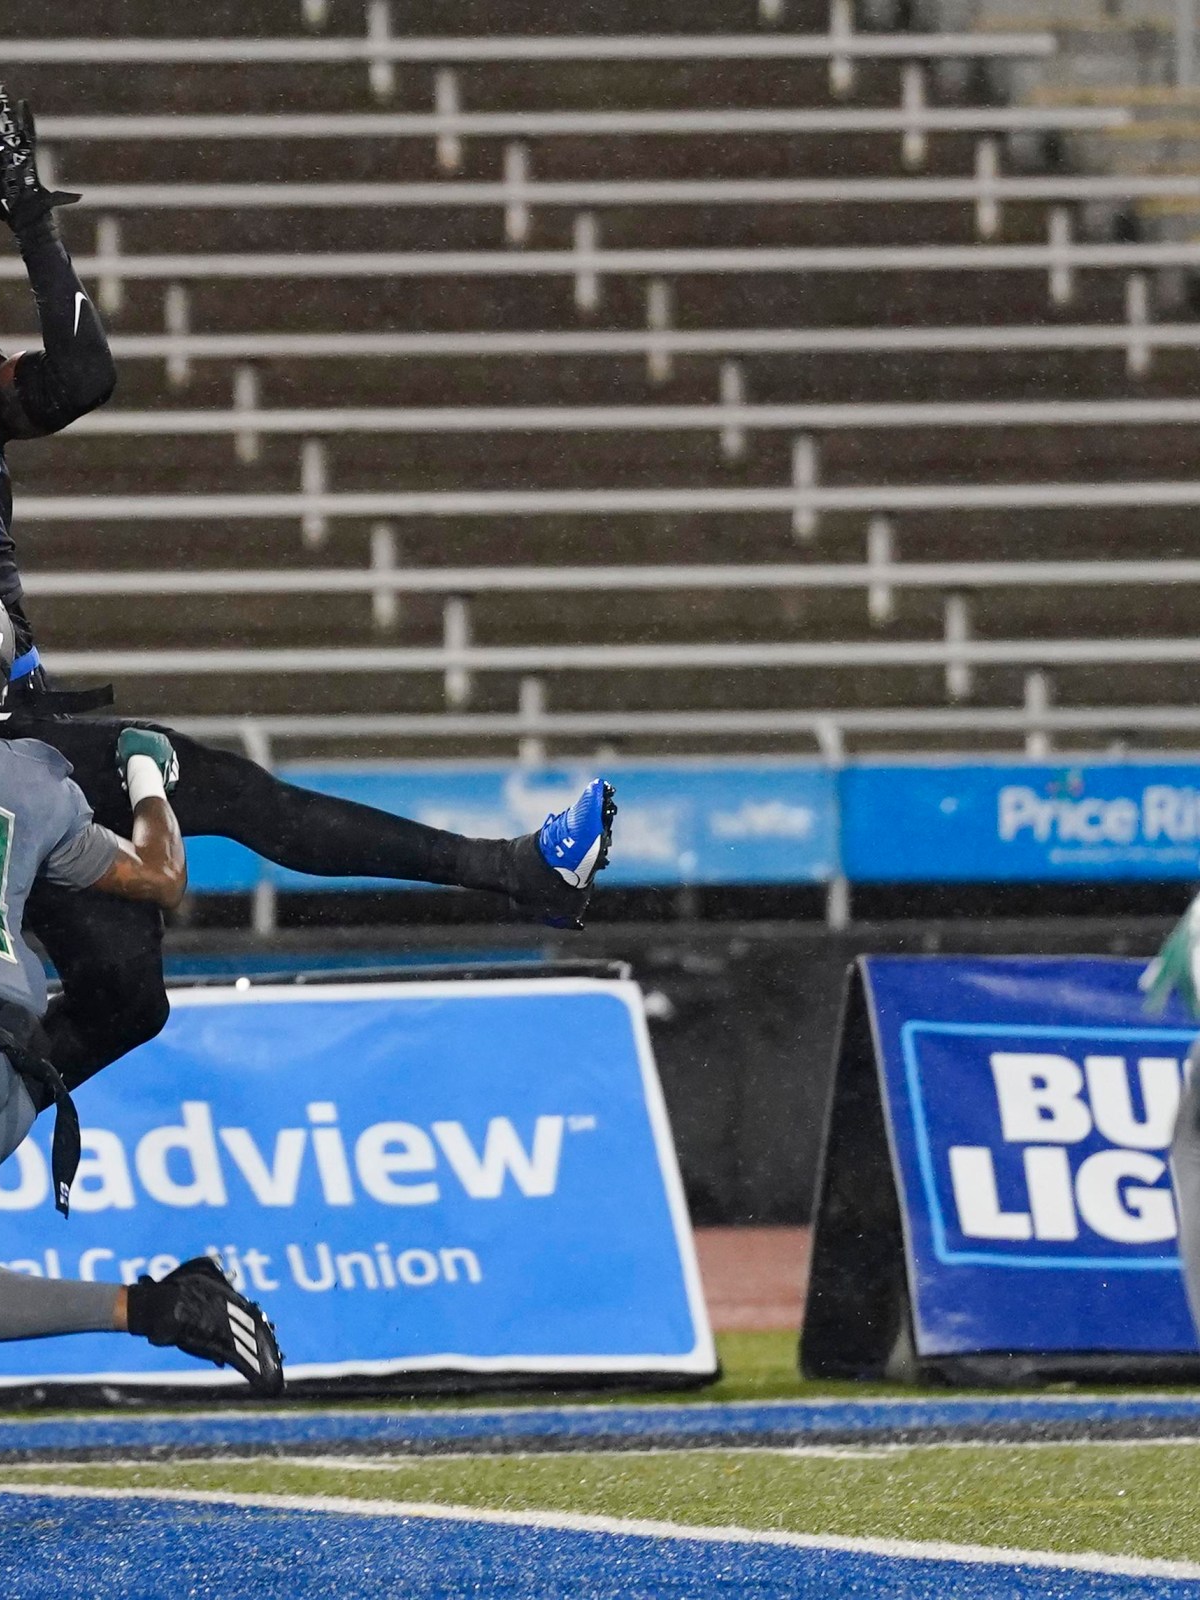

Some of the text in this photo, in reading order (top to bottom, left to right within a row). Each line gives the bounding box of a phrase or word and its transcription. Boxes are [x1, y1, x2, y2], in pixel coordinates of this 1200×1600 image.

[998, 784, 1200, 842] Price Ri
[990, 1052, 1191, 1150] BU
[948, 1146, 1178, 1244] LIG
[78, 1245, 279, 1293] Creit
[286, 1242, 482, 1292] Union
